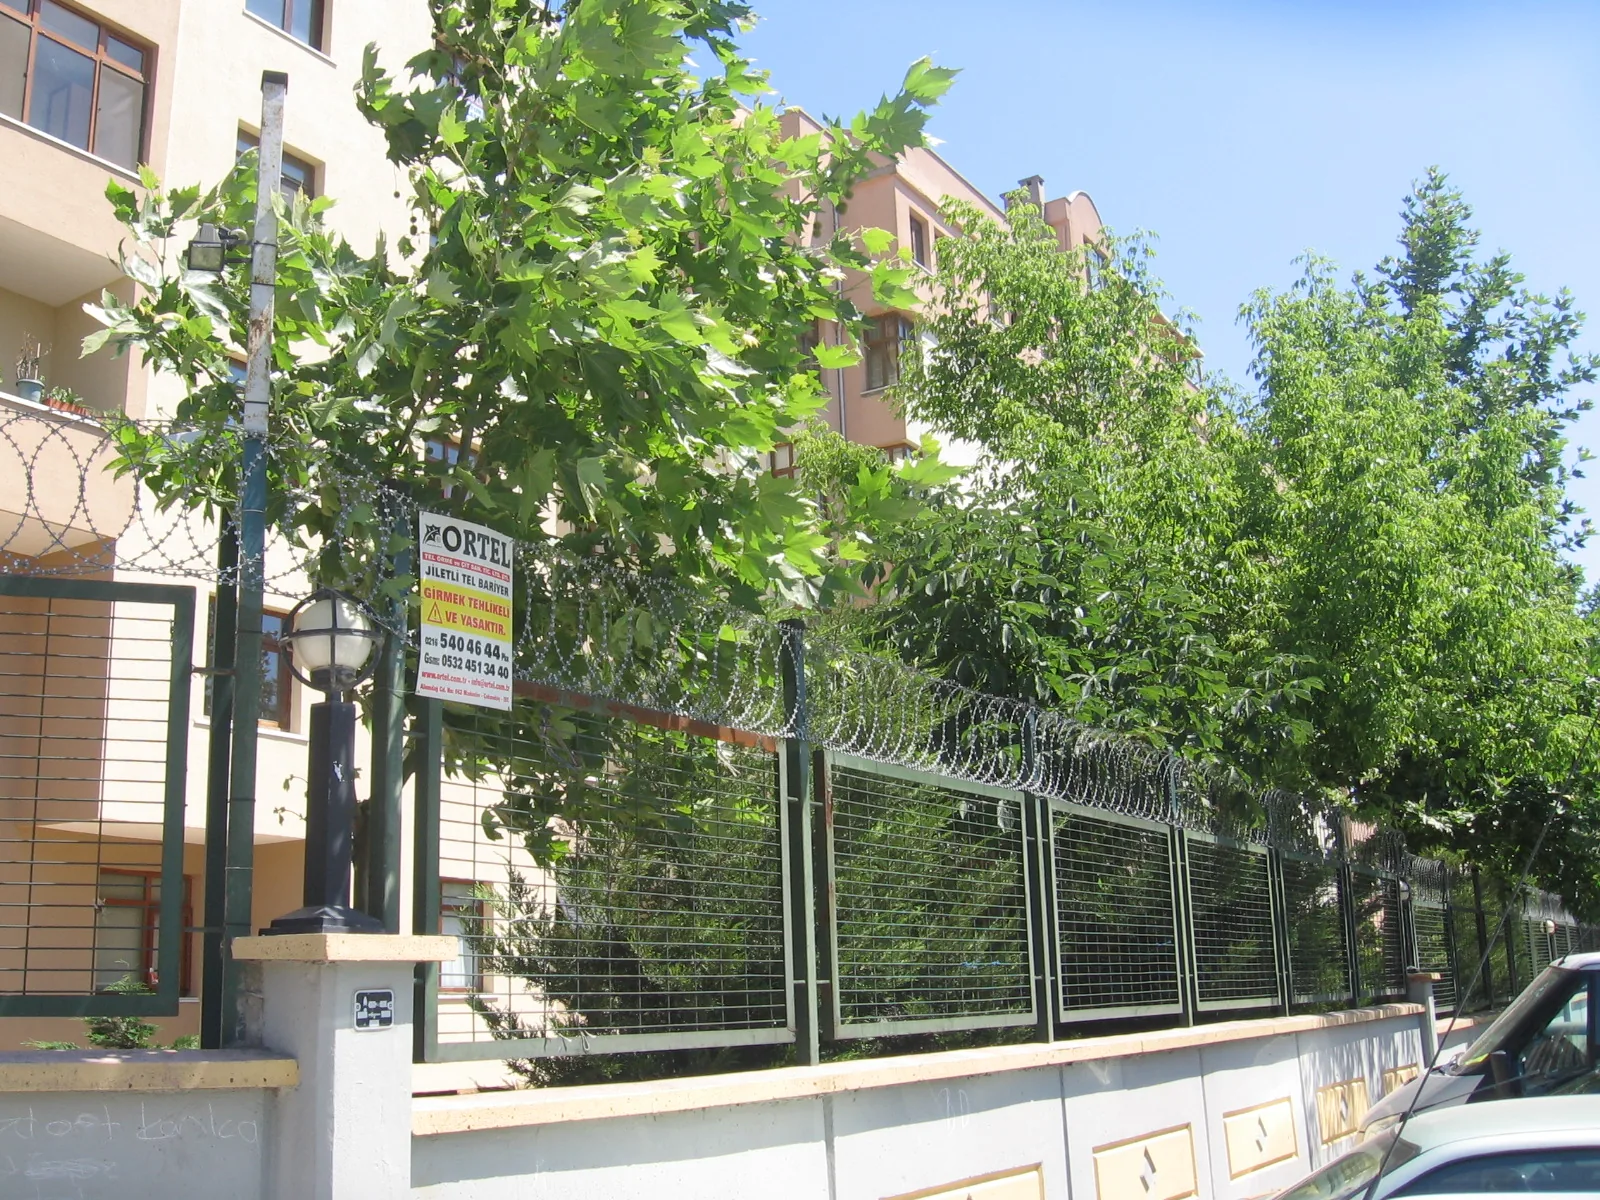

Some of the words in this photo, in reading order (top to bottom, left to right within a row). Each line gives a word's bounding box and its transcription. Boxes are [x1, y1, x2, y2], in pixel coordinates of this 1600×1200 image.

[442, 525, 510, 569] ORTEL
[423, 585, 465, 606] GİRMEK
[462, 573, 476, 587] TEL
[478, 579, 509, 597] BARİYER
[445, 610, 458, 624] VE
[440, 633, 464, 652] 540
[466, 639, 482, 656] 46
[484, 642, 501, 660] 44
[441, 654, 463, 670] 0532
[464, 658, 482, 674] 451
[483, 662, 496, 676] 34
[497, 665, 509, 680] 40
